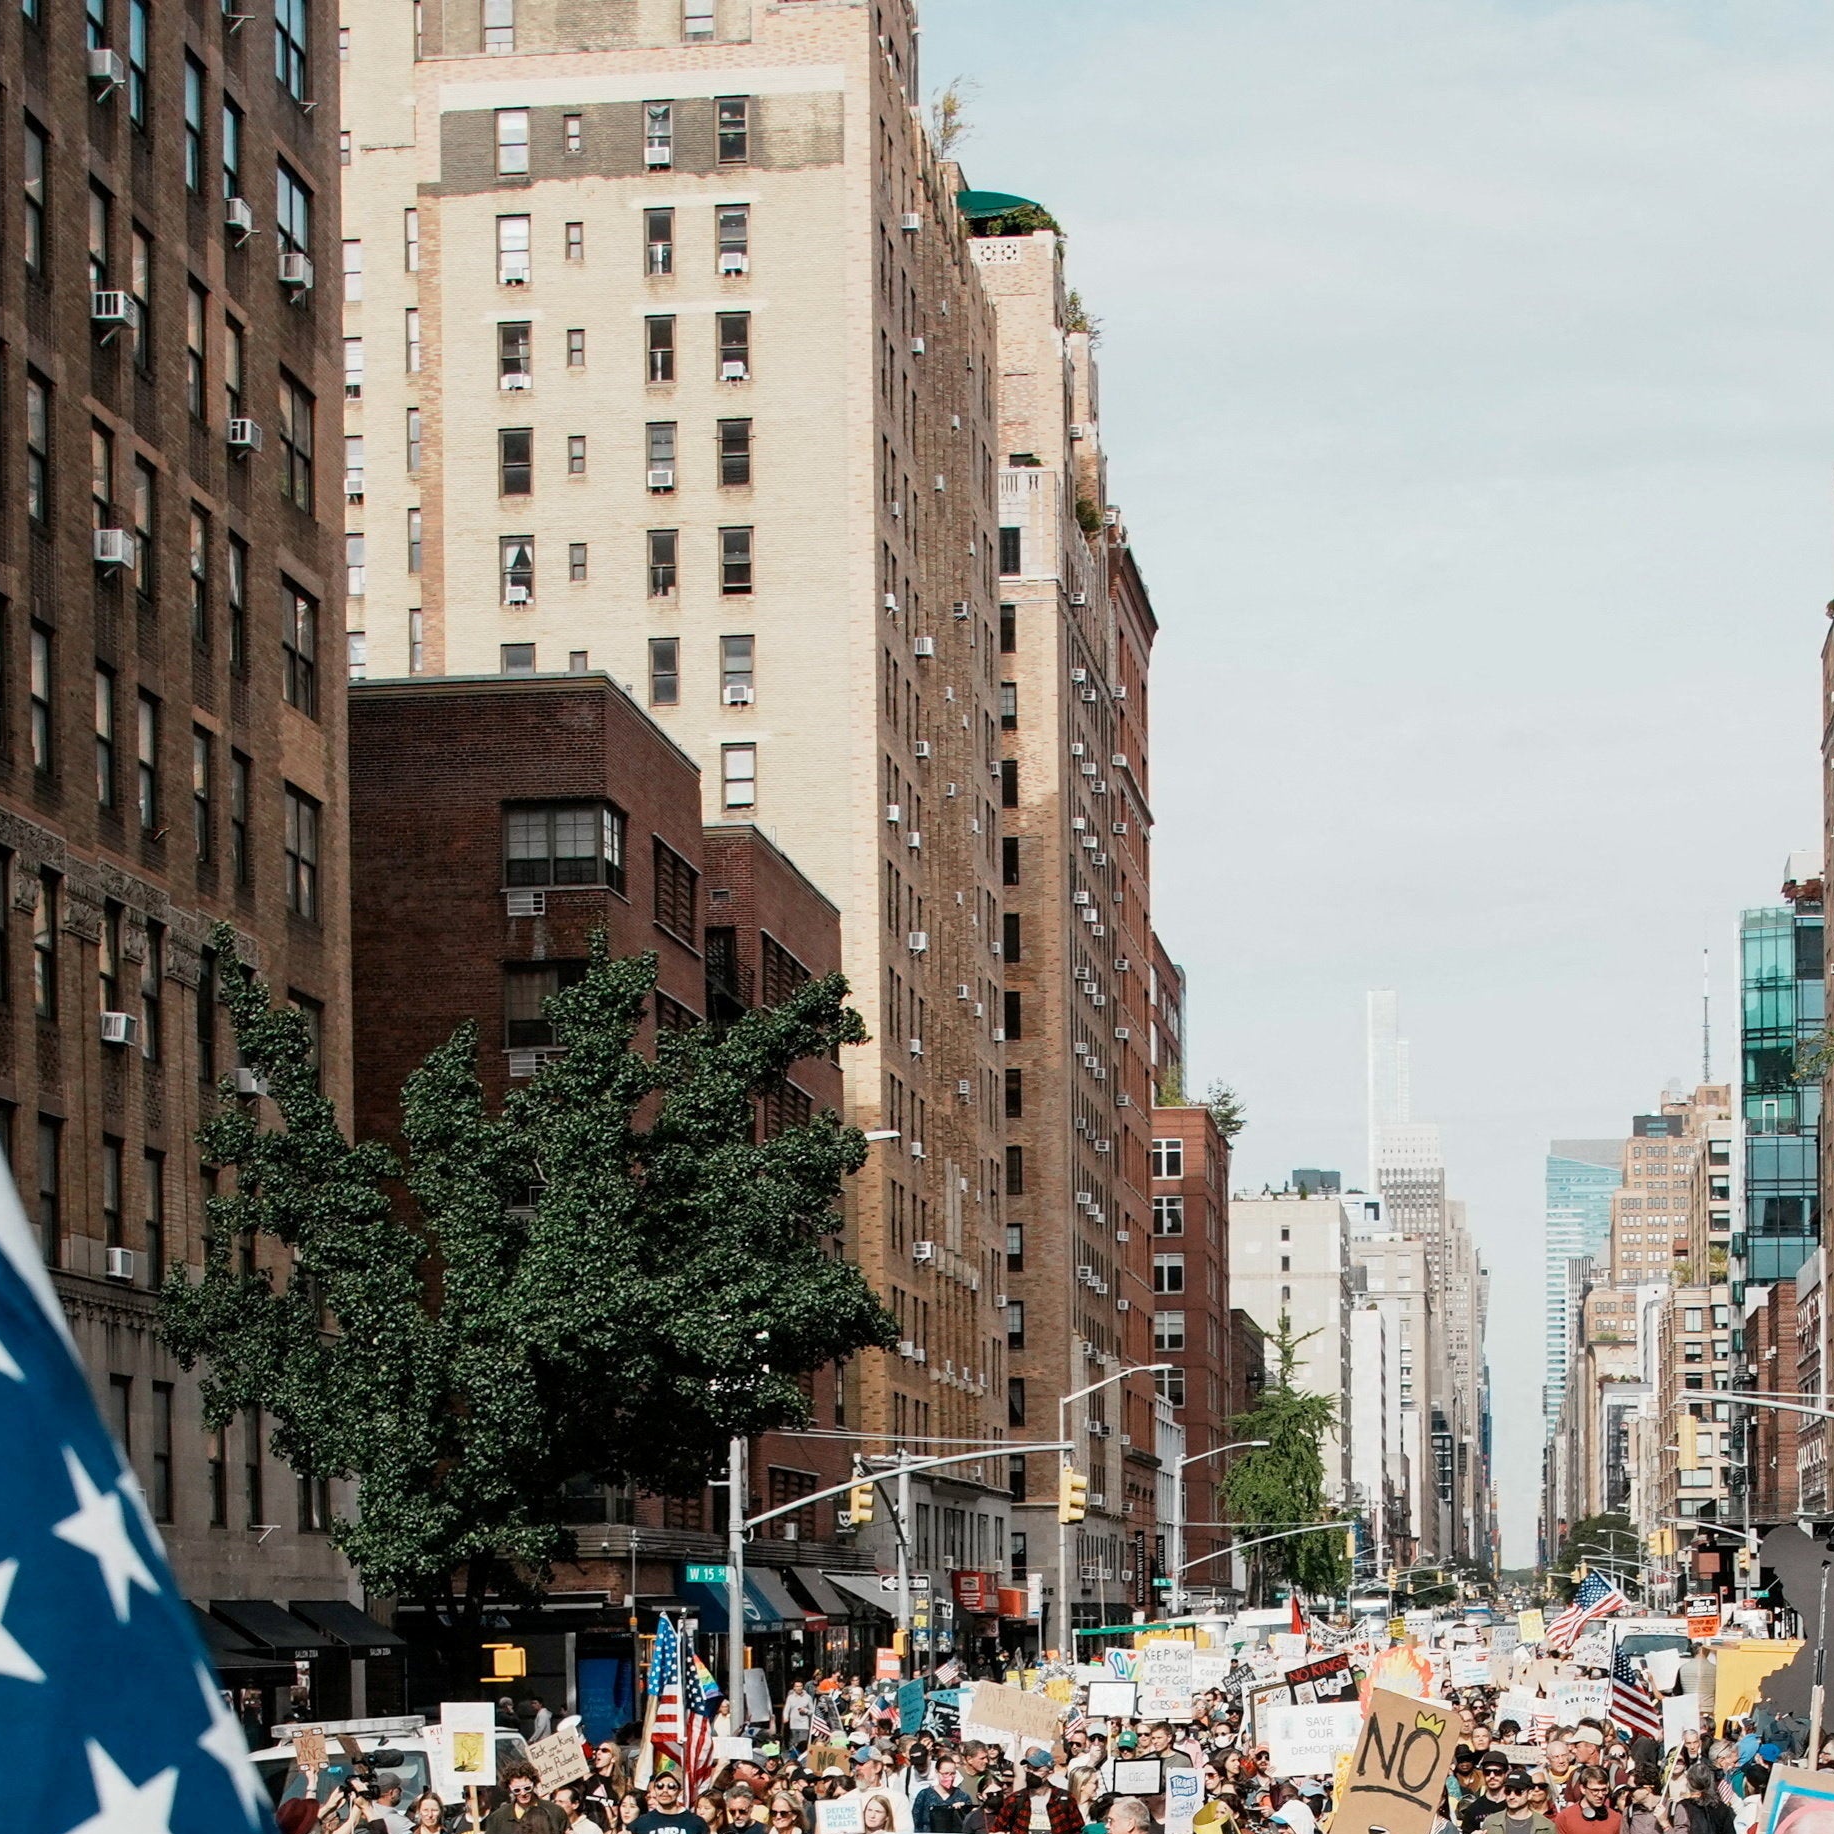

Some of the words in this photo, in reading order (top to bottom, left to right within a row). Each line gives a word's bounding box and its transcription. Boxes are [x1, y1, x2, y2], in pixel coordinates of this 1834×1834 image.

[690, 1567, 699, 1580] W
[703, 1567, 715, 1580] 15
[1144, 1648, 1171, 1663] KEEP
[1289, 1668, 1309, 1681] NO
[1311, 1655, 1348, 1677] KINGS
[1223, 1664, 1250, 1686] DUMP
[1306, 1716, 1335, 1726] SAVE
[1308, 1729, 1334, 1738] OUR
[530, 1745, 547, 1760] Fuck
[1291, 1744, 1354, 1755] DEMOCRACY
[1357, 1712, 1440, 1793] NO
[825, 1805, 857, 1815] DEFEND
[826, 1812, 857, 1821] PUBLIC
[826, 1818, 859, 1828] HEALTH
